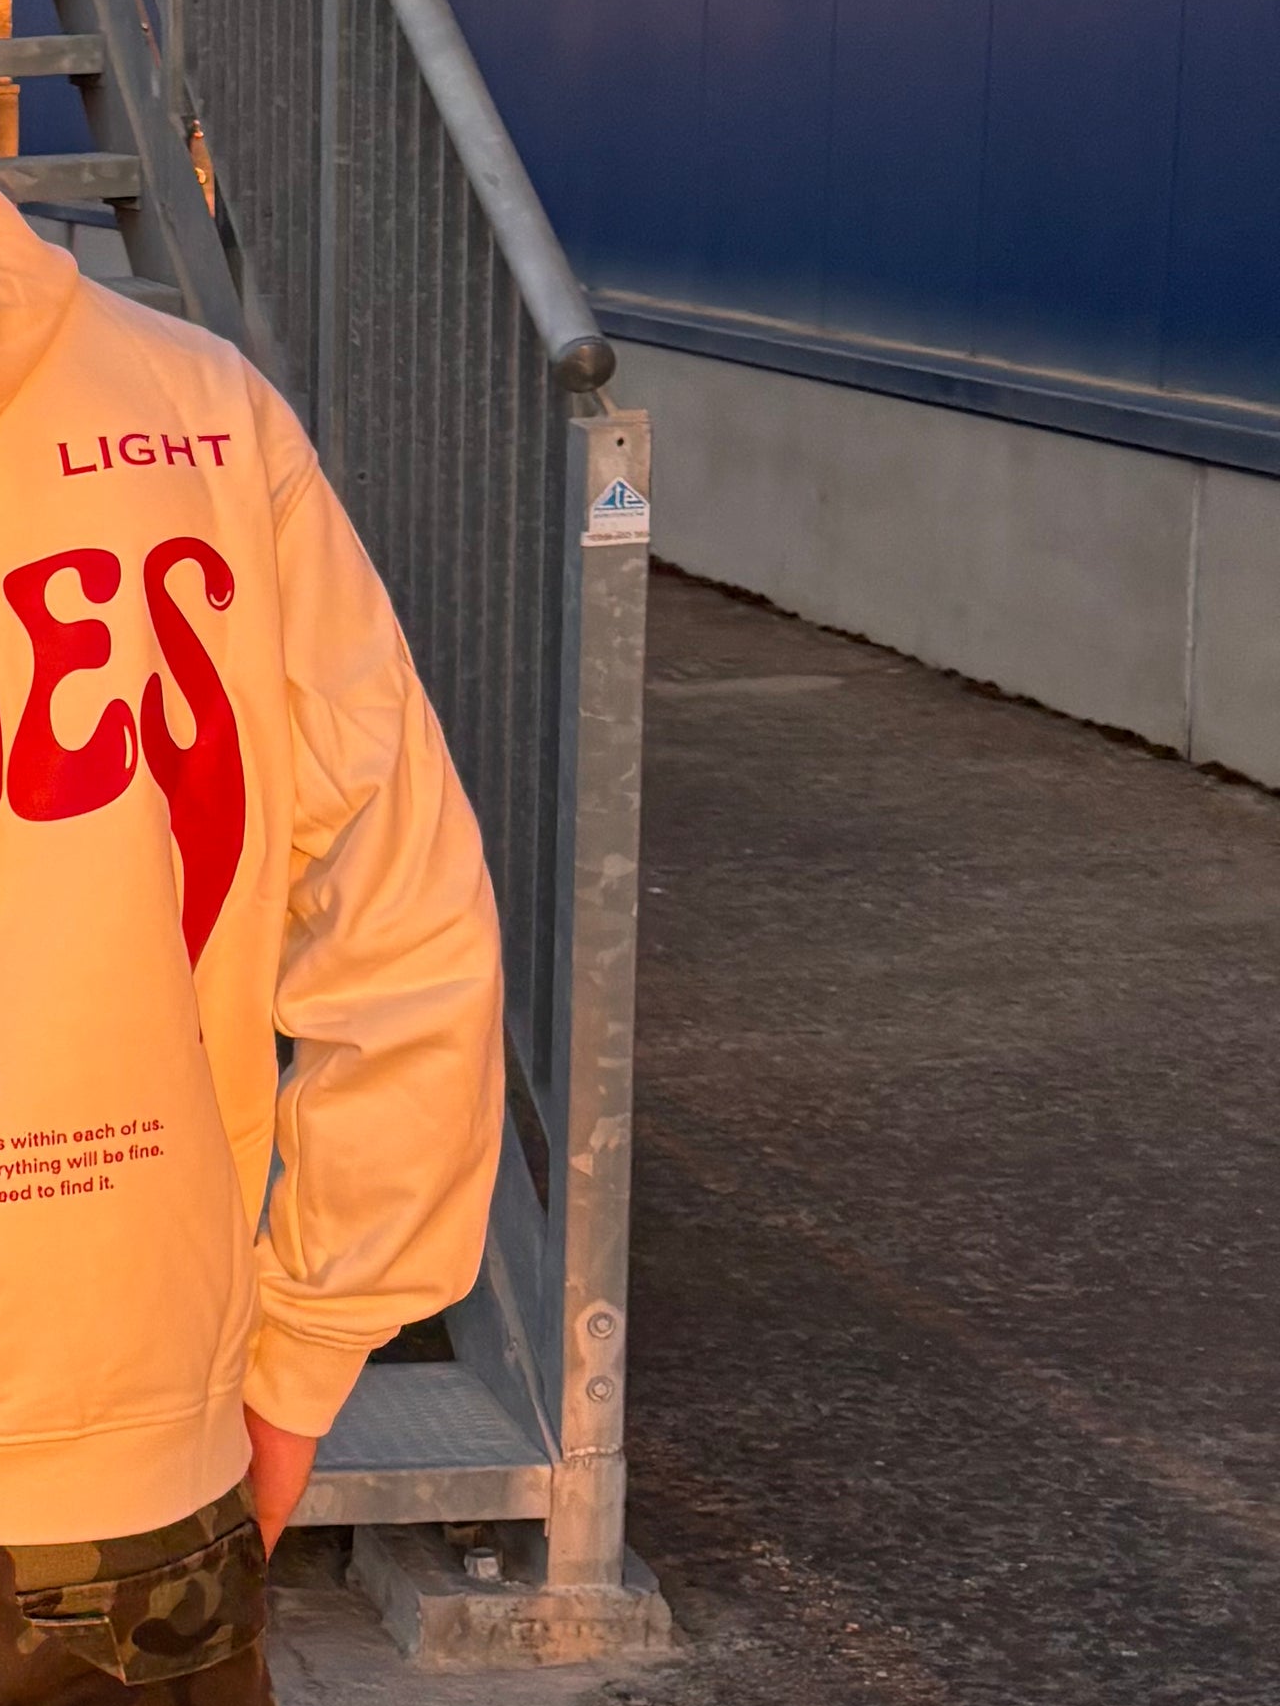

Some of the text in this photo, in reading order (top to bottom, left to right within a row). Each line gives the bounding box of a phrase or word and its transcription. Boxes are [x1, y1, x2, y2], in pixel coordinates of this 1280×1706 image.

[57, 432, 233, 477] LIGHT
[11, 1129, 68, 1150] within
[73, 1123, 116, 1143] each
[120, 1119, 137, 1136] of
[142, 1118, 165, 1134] us.
[66, 1150, 98, 1169] will
[103, 1149, 125, 1165] be
[128, 1144, 165, 1161] fine.
[37, 1184, 56, 1199] to
[60, 1177, 94, 1197] find
[98, 1175, 115, 1192] it.
